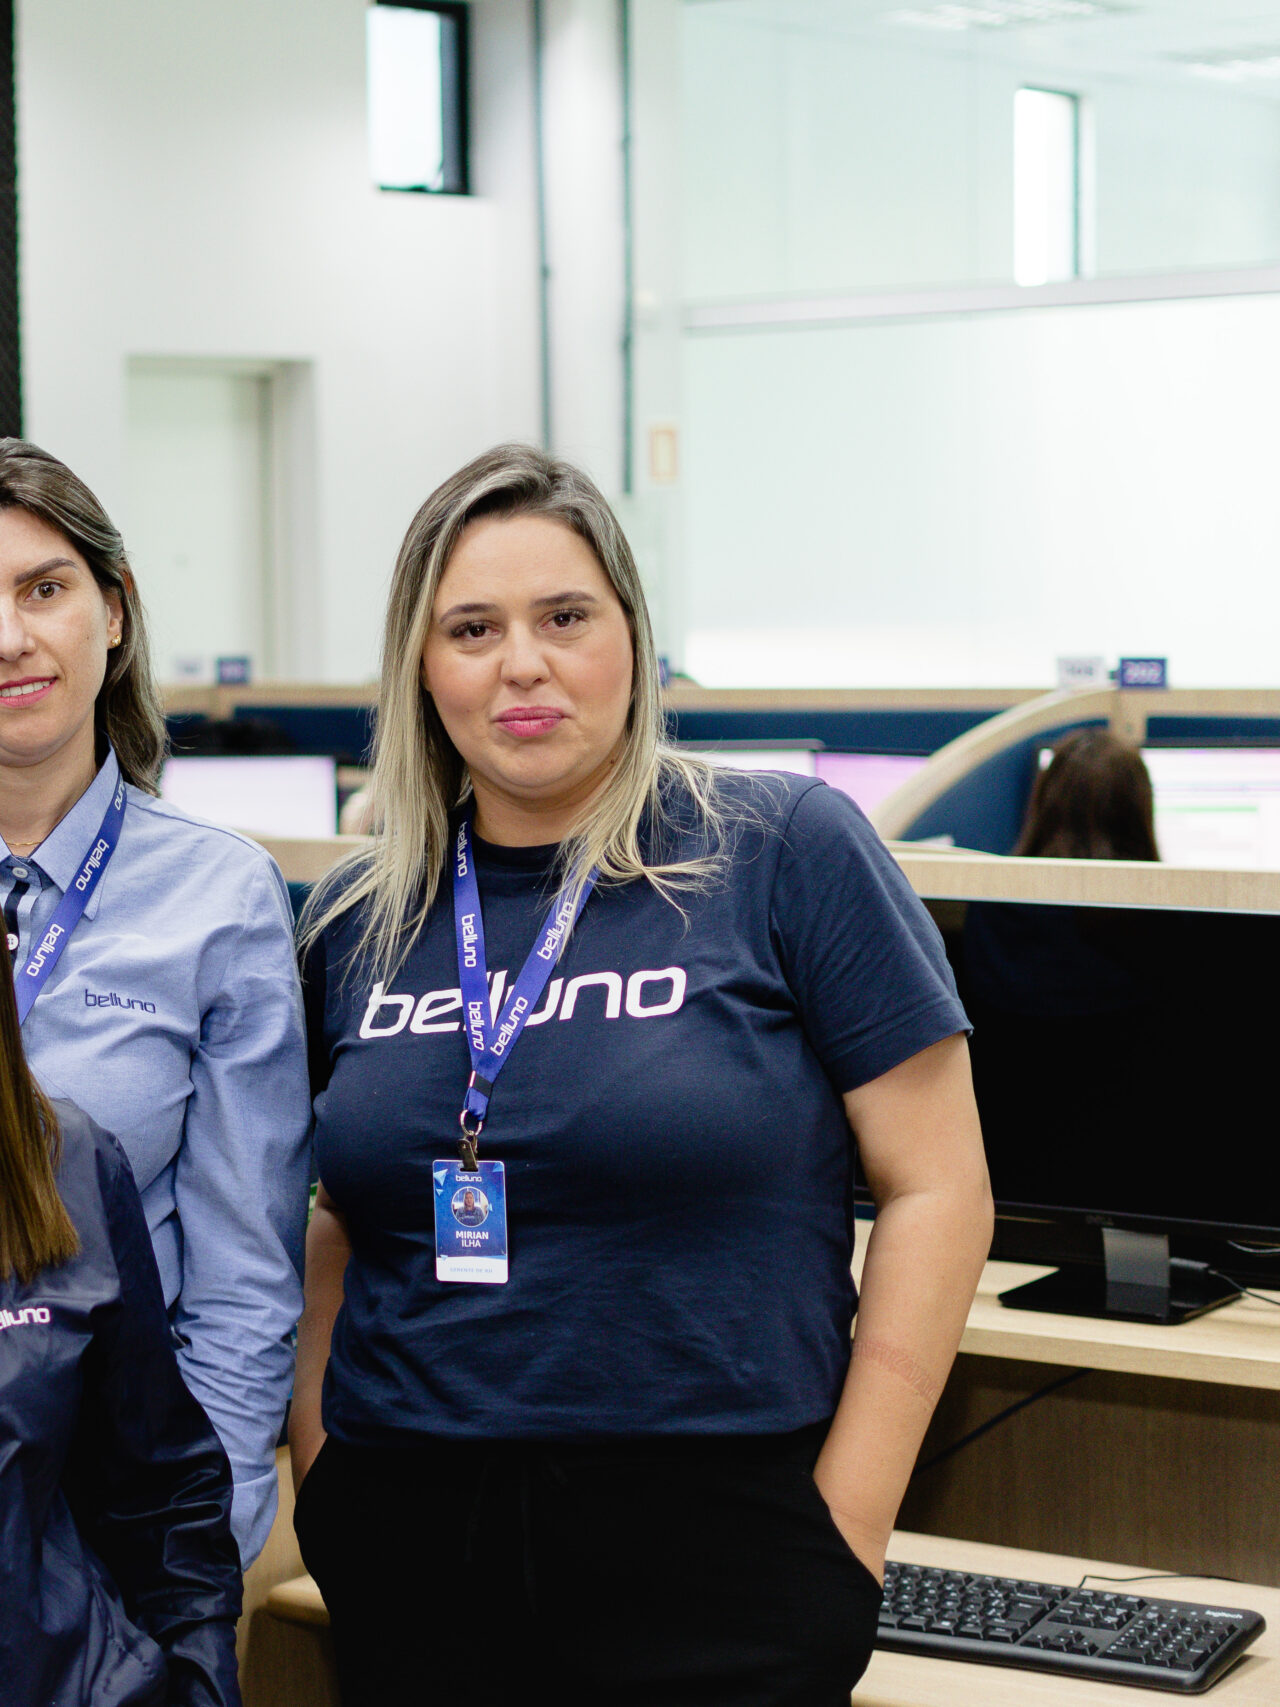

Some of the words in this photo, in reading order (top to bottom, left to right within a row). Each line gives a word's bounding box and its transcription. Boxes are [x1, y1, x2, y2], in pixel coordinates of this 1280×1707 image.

[75, 838, 110, 892] belluno
[26, 923, 65, 978] belluno
[461, 913, 478, 968] belluno
[536, 901, 574, 961] belluno
[84, 988, 156, 1014] belluno
[468, 1001, 485, 1051] belluno
[489, 996, 529, 1057] belluno
[455, 1174, 483, 1183] belluno
[455, 1230, 489, 1240] MIRIAN
[461, 1239, 482, 1248] ILHA
[1204, 1609, 1244, 1620] logitech
